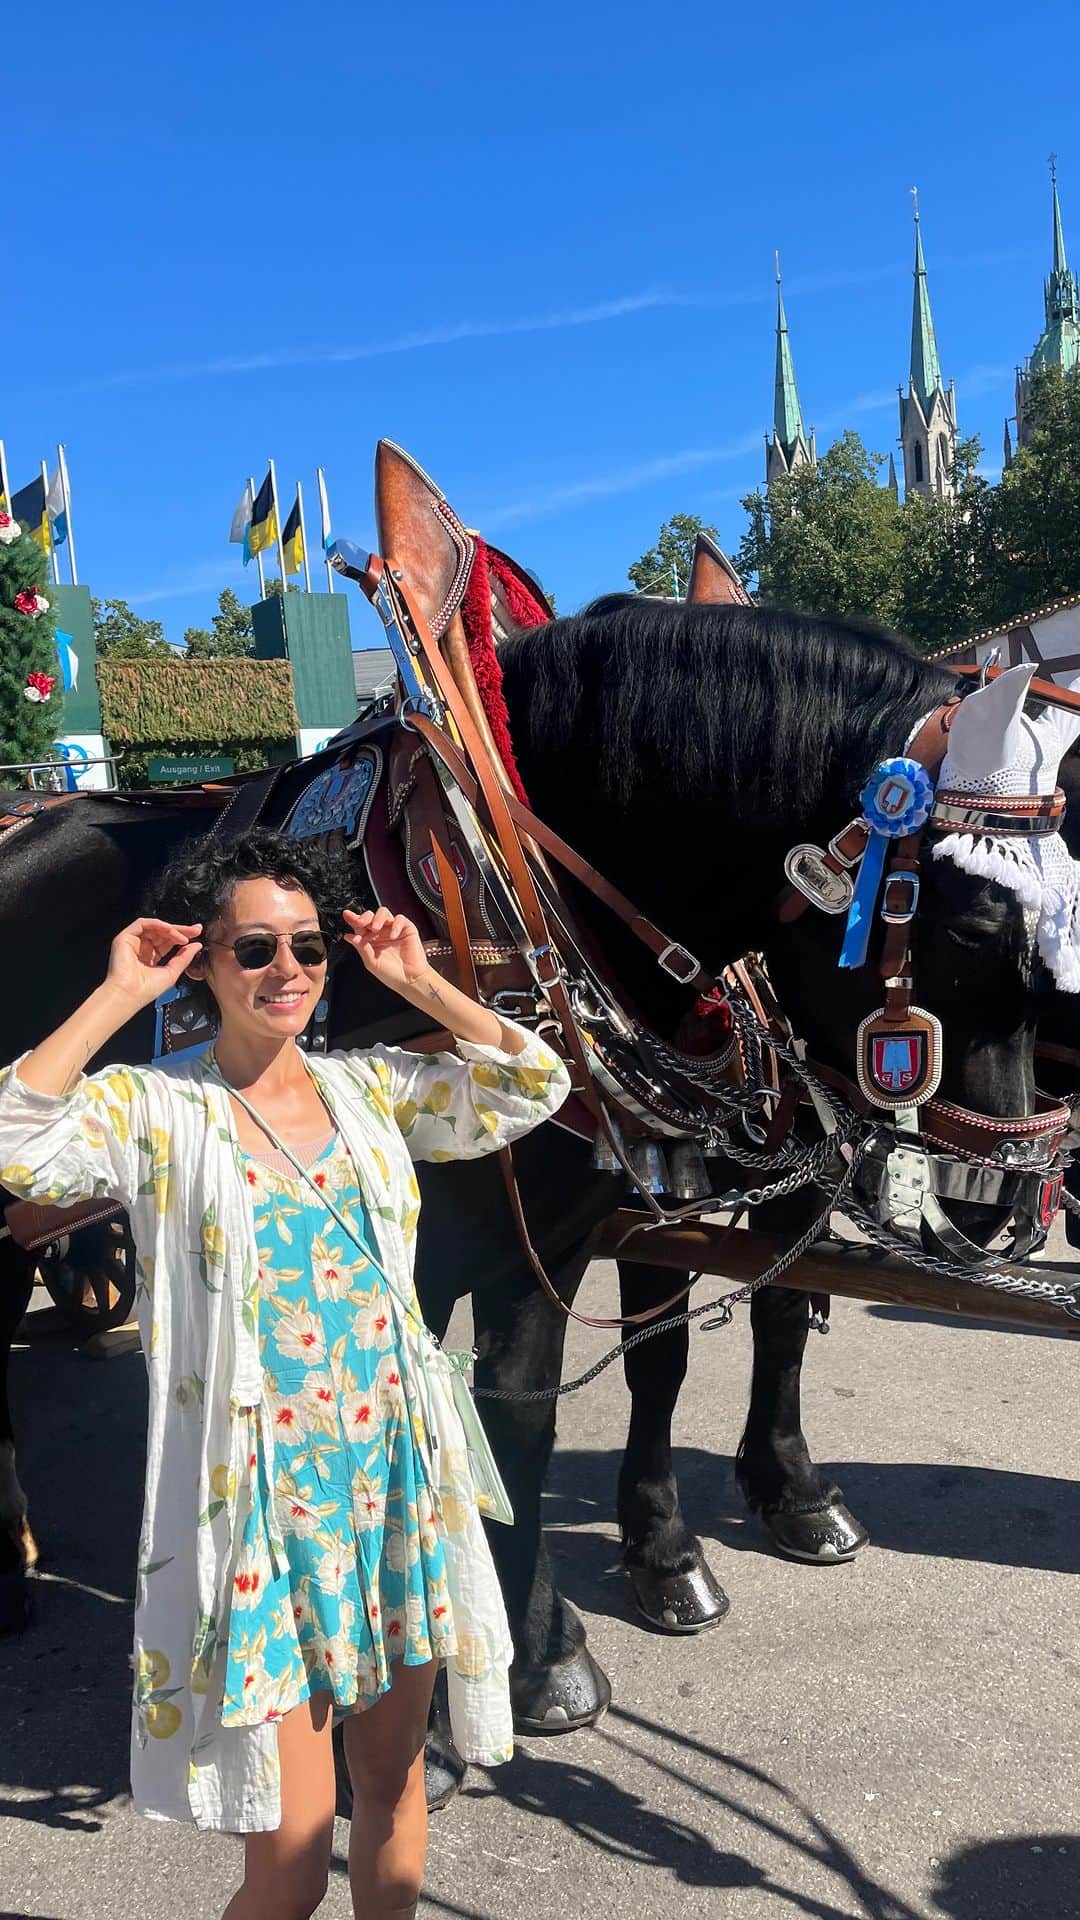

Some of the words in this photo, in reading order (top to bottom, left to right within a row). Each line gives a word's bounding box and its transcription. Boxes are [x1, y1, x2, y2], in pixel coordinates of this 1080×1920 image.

[160, 765, 198, 775] Ausgang
[204, 764, 221, 773] Exit
[882, 1073, 892, 1082] G
[902, 1072, 913, 1082] S
